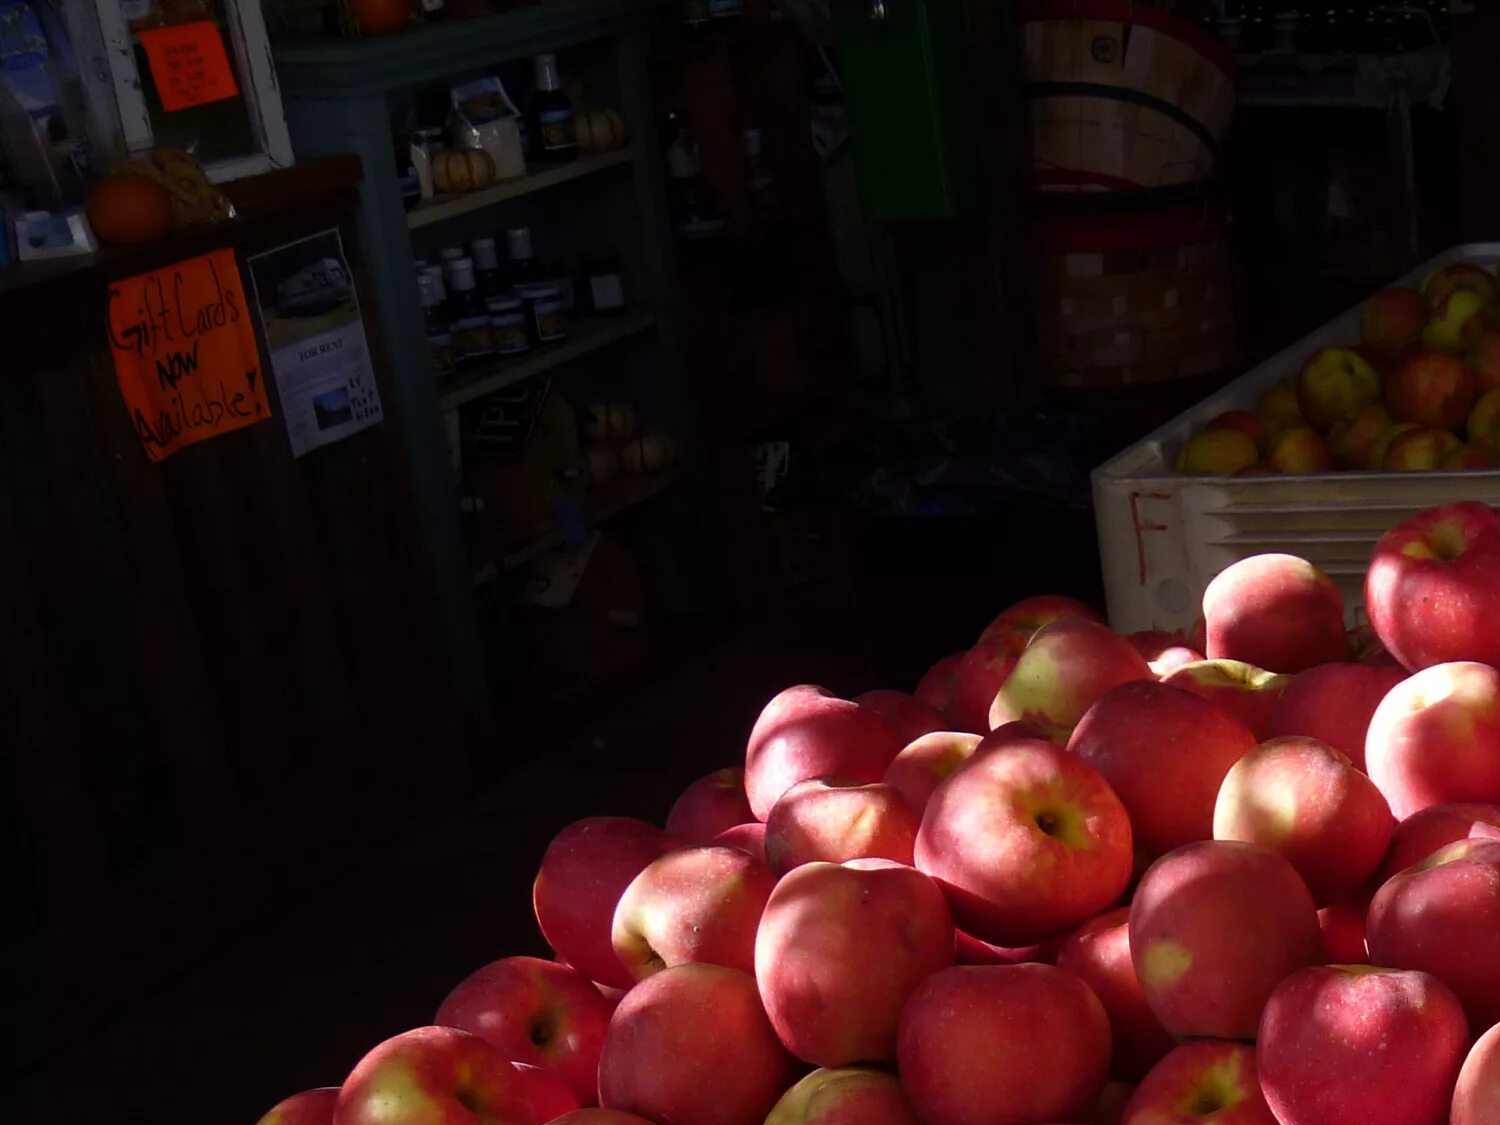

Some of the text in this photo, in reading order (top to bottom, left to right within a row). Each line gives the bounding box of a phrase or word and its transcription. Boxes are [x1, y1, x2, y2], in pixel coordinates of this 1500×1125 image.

[106, 257, 240, 356] Gift Cards
[135, 370, 263, 448] Available!
